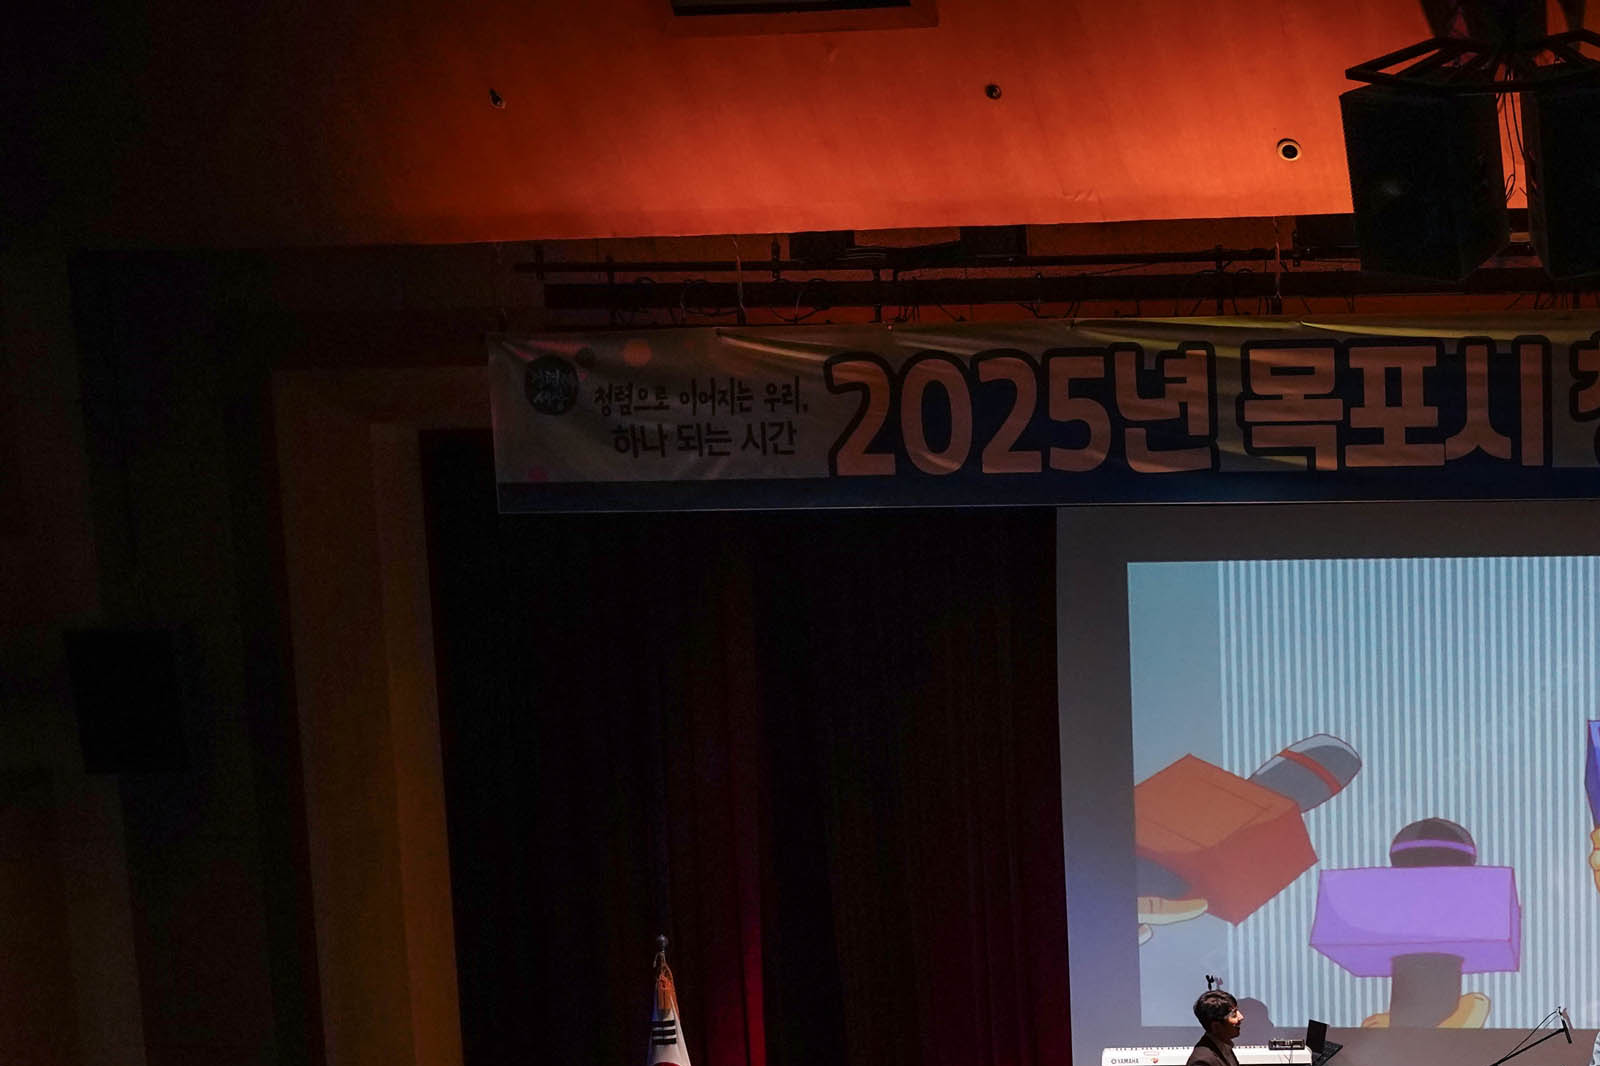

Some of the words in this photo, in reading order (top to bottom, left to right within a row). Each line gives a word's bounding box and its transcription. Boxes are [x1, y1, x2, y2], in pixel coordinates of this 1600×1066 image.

[594, 382, 670, 416] 청렴으로
[679, 377, 753, 416] 이어지는
[763, 375, 808, 413] 우리,
[826, 344, 1214, 477] 2025년
[1241, 338, 1547, 472] 목포시
[612, 423, 668, 458] 하나
[677, 422, 732, 457] 되는
[741, 420, 797, 456] 시간
